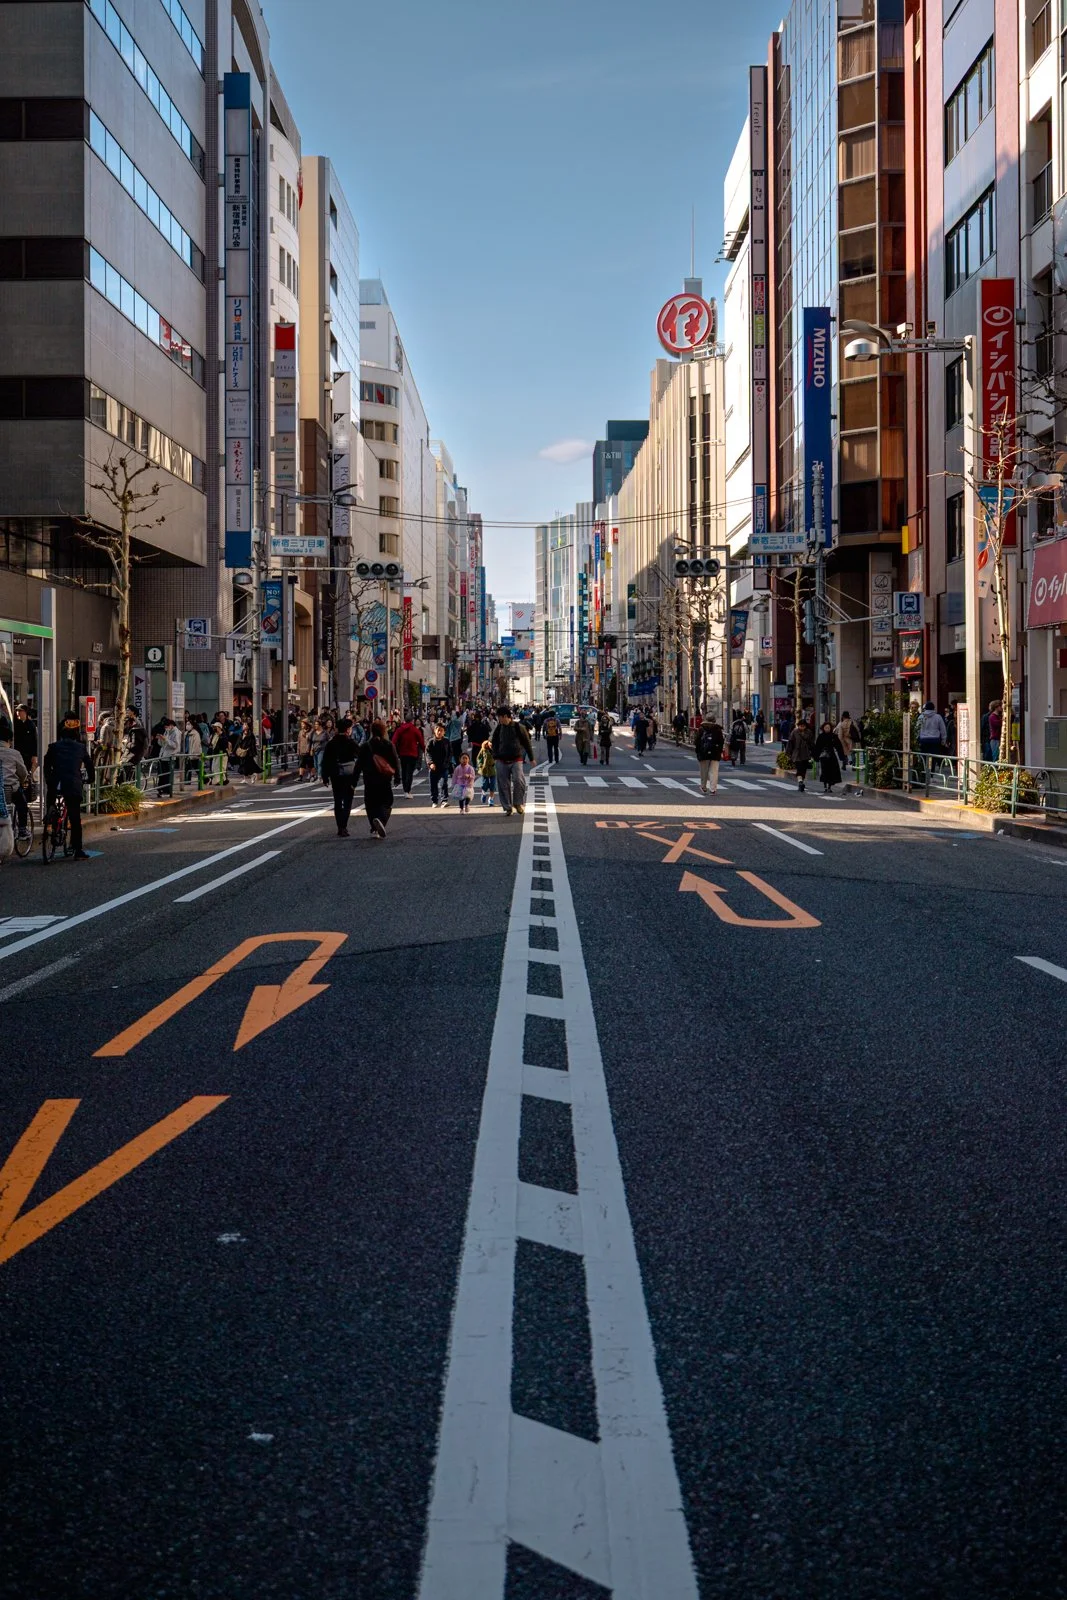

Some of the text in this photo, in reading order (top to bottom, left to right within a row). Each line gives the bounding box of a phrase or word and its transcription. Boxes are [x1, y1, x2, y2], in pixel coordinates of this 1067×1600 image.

[813, 327, 826, 388] MIZUHO
[272, 538, 325, 548] 新宿三丁目東
[751, 535, 805, 545] 新宿三丁目東
